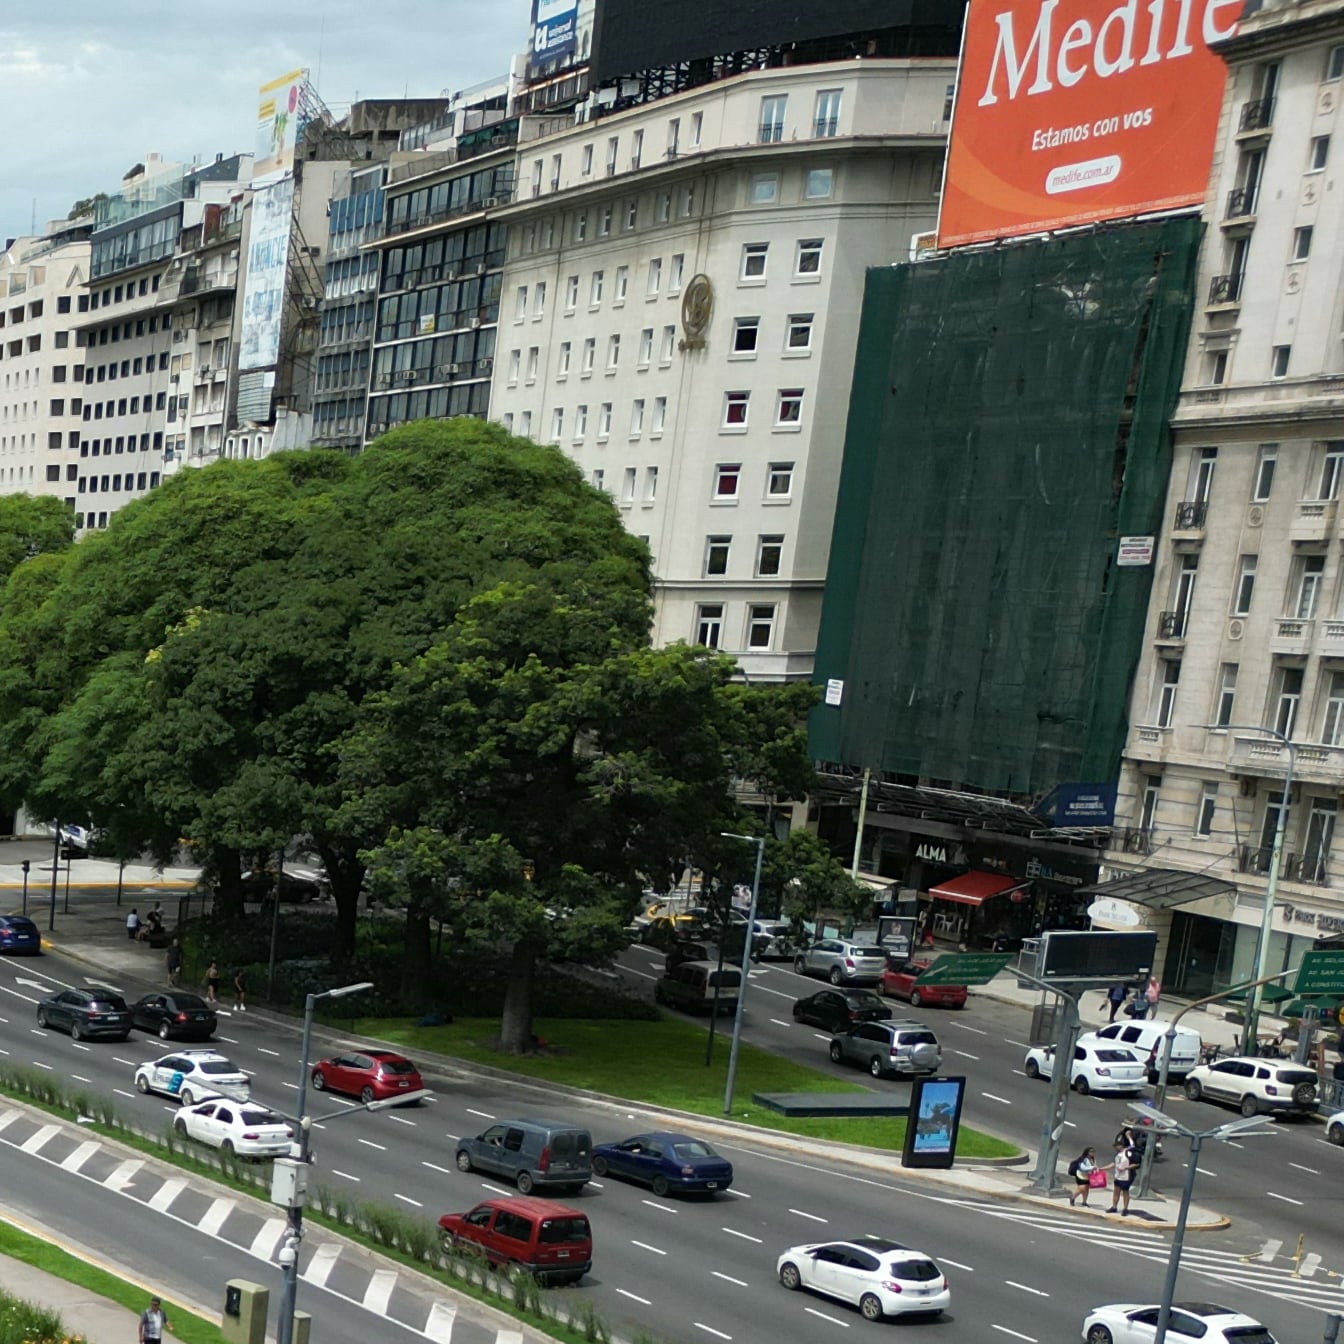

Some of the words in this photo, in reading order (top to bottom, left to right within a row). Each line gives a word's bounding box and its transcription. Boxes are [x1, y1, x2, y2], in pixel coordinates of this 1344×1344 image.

[1032, 122, 1089, 151] Estamos
[1093, 116, 1119, 138] con
[1122, 107, 1152, 130] vos
[915, 843, 946, 863] ALMA
